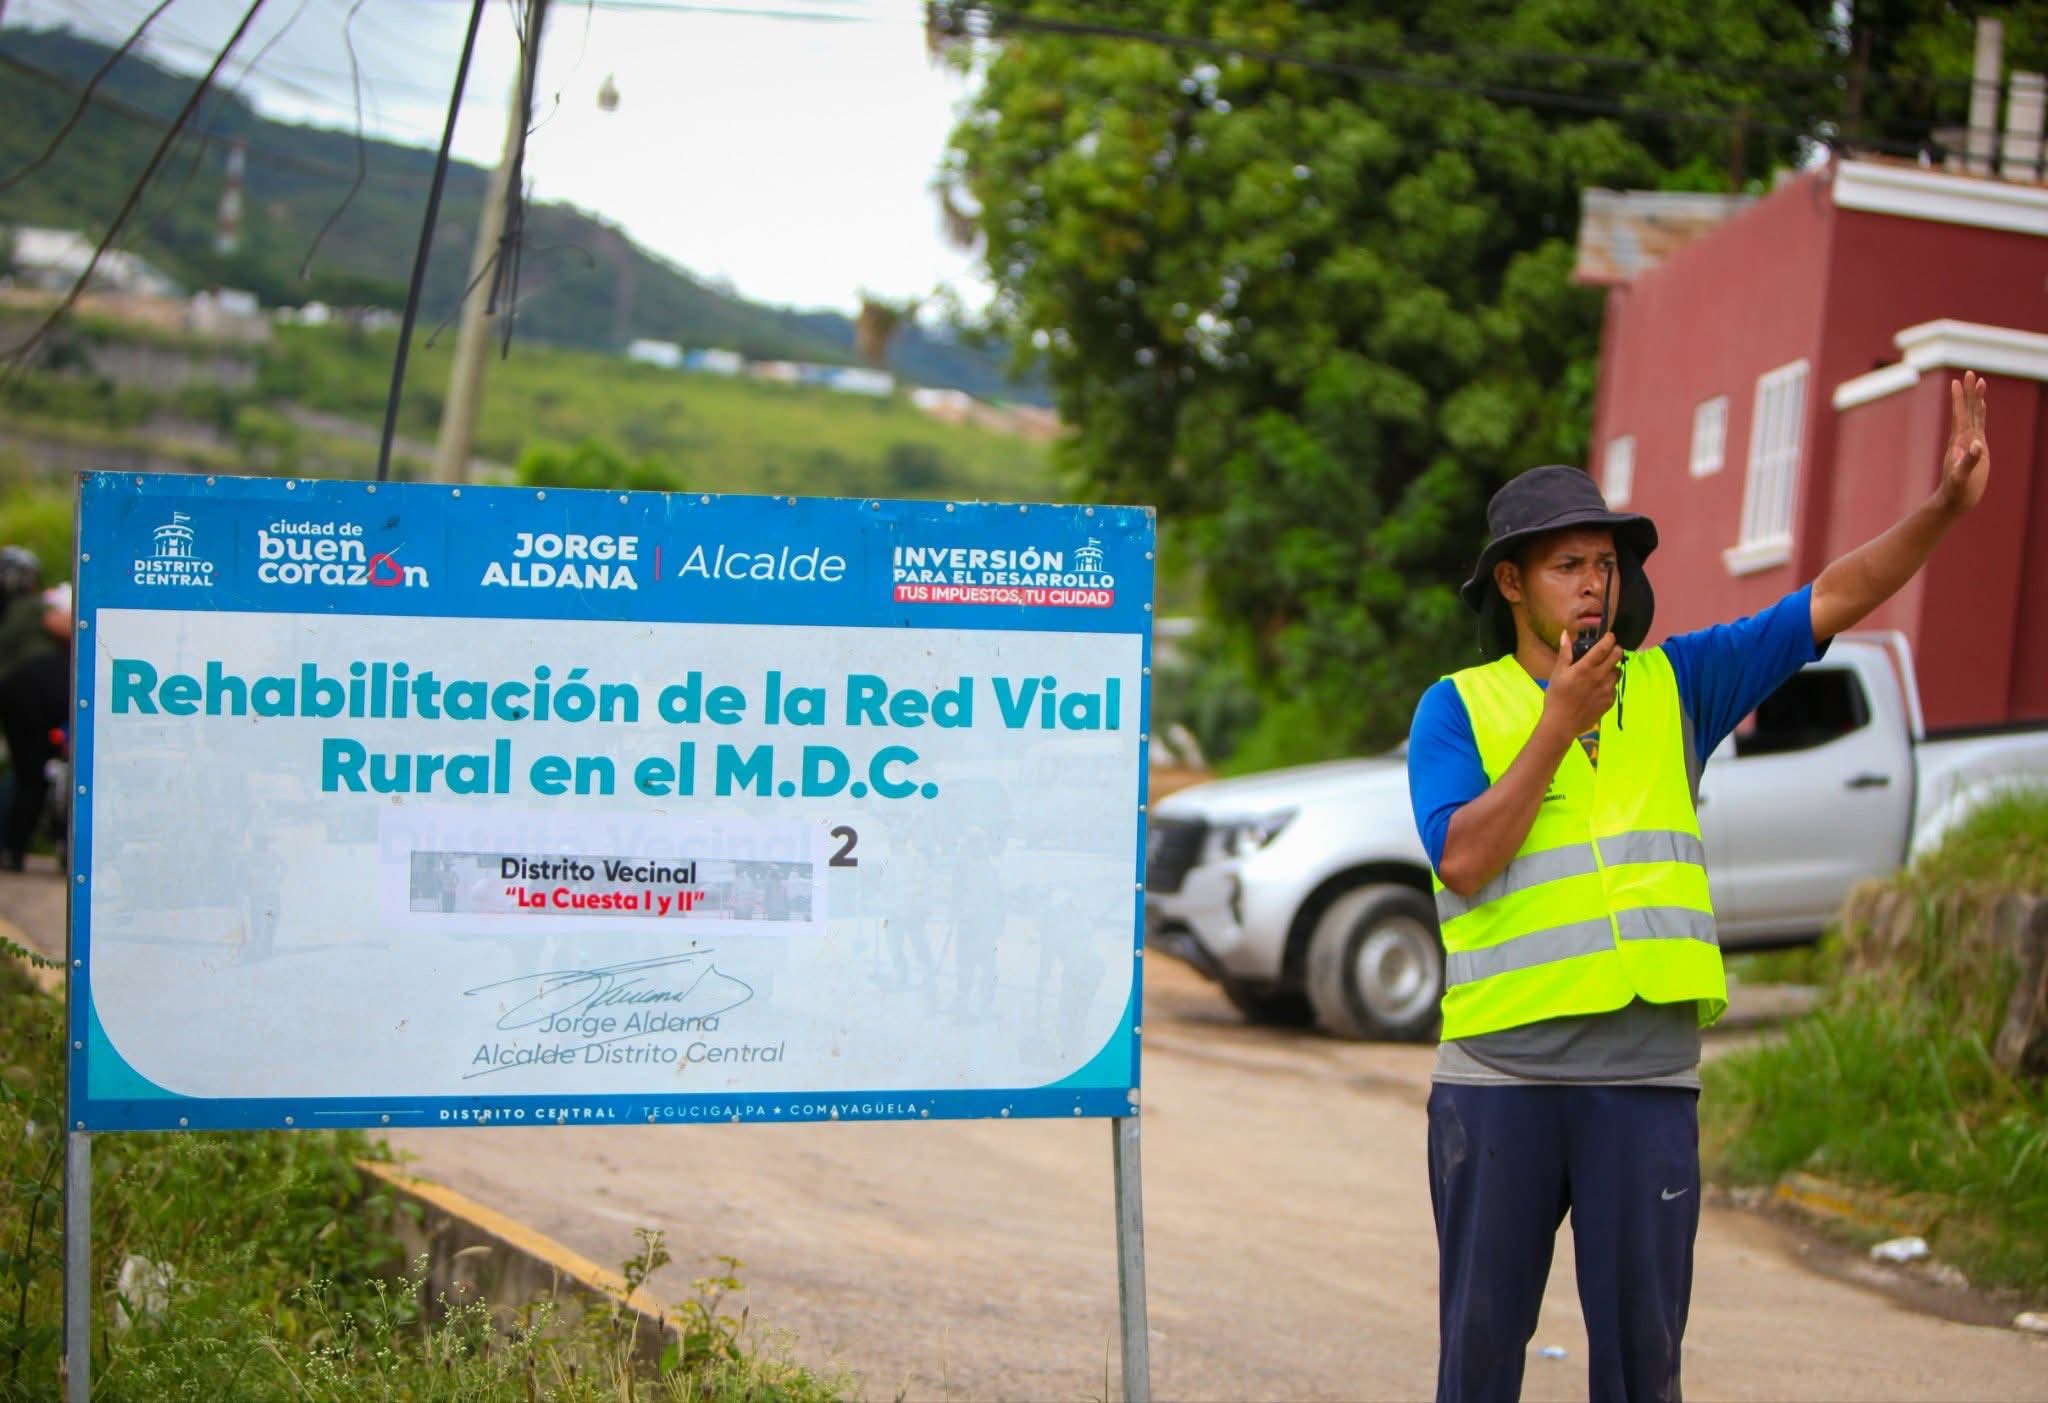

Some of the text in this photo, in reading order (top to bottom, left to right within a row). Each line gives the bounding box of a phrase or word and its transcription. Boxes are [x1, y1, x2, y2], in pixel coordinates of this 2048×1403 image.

[270, 519, 363, 536] ciudad de
[258, 530, 366, 562] buen
[514, 533, 638, 561] JORGE
[894, 546, 1063, 571] INVERSIÓN
[134, 559, 214, 574] DISTRITO
[480, 562, 638, 590] ALDANA
[678, 544, 847, 582] Alcalde
[134, 573, 214, 587] CENTRAL
[893, 568, 1114, 589] PARA EL DESARROLLO
[897, 585, 1110, 605] TUS IMPUESTOS, TU CIUDAD
[111, 659, 1121, 731] Rehabilitación de la Red Vial
[321, 738, 940, 799] Rural en el M.D.C.
[828, 825, 859, 867] 2
[501, 857, 696, 884] Distrito Vecinal
[552, 887, 639, 910] Cuesta
[657, 895, 671, 916] y
[539, 1012, 719, 1038] Jorge Aldana
[472, 1041, 784, 1065] Alcalde Distrito Central
[440, 1108, 525, 1120] DISTRITO
[535, 1107, 616, 1119] CENTRAL
[642, 1105, 765, 1118] TEGUCIGALPA
